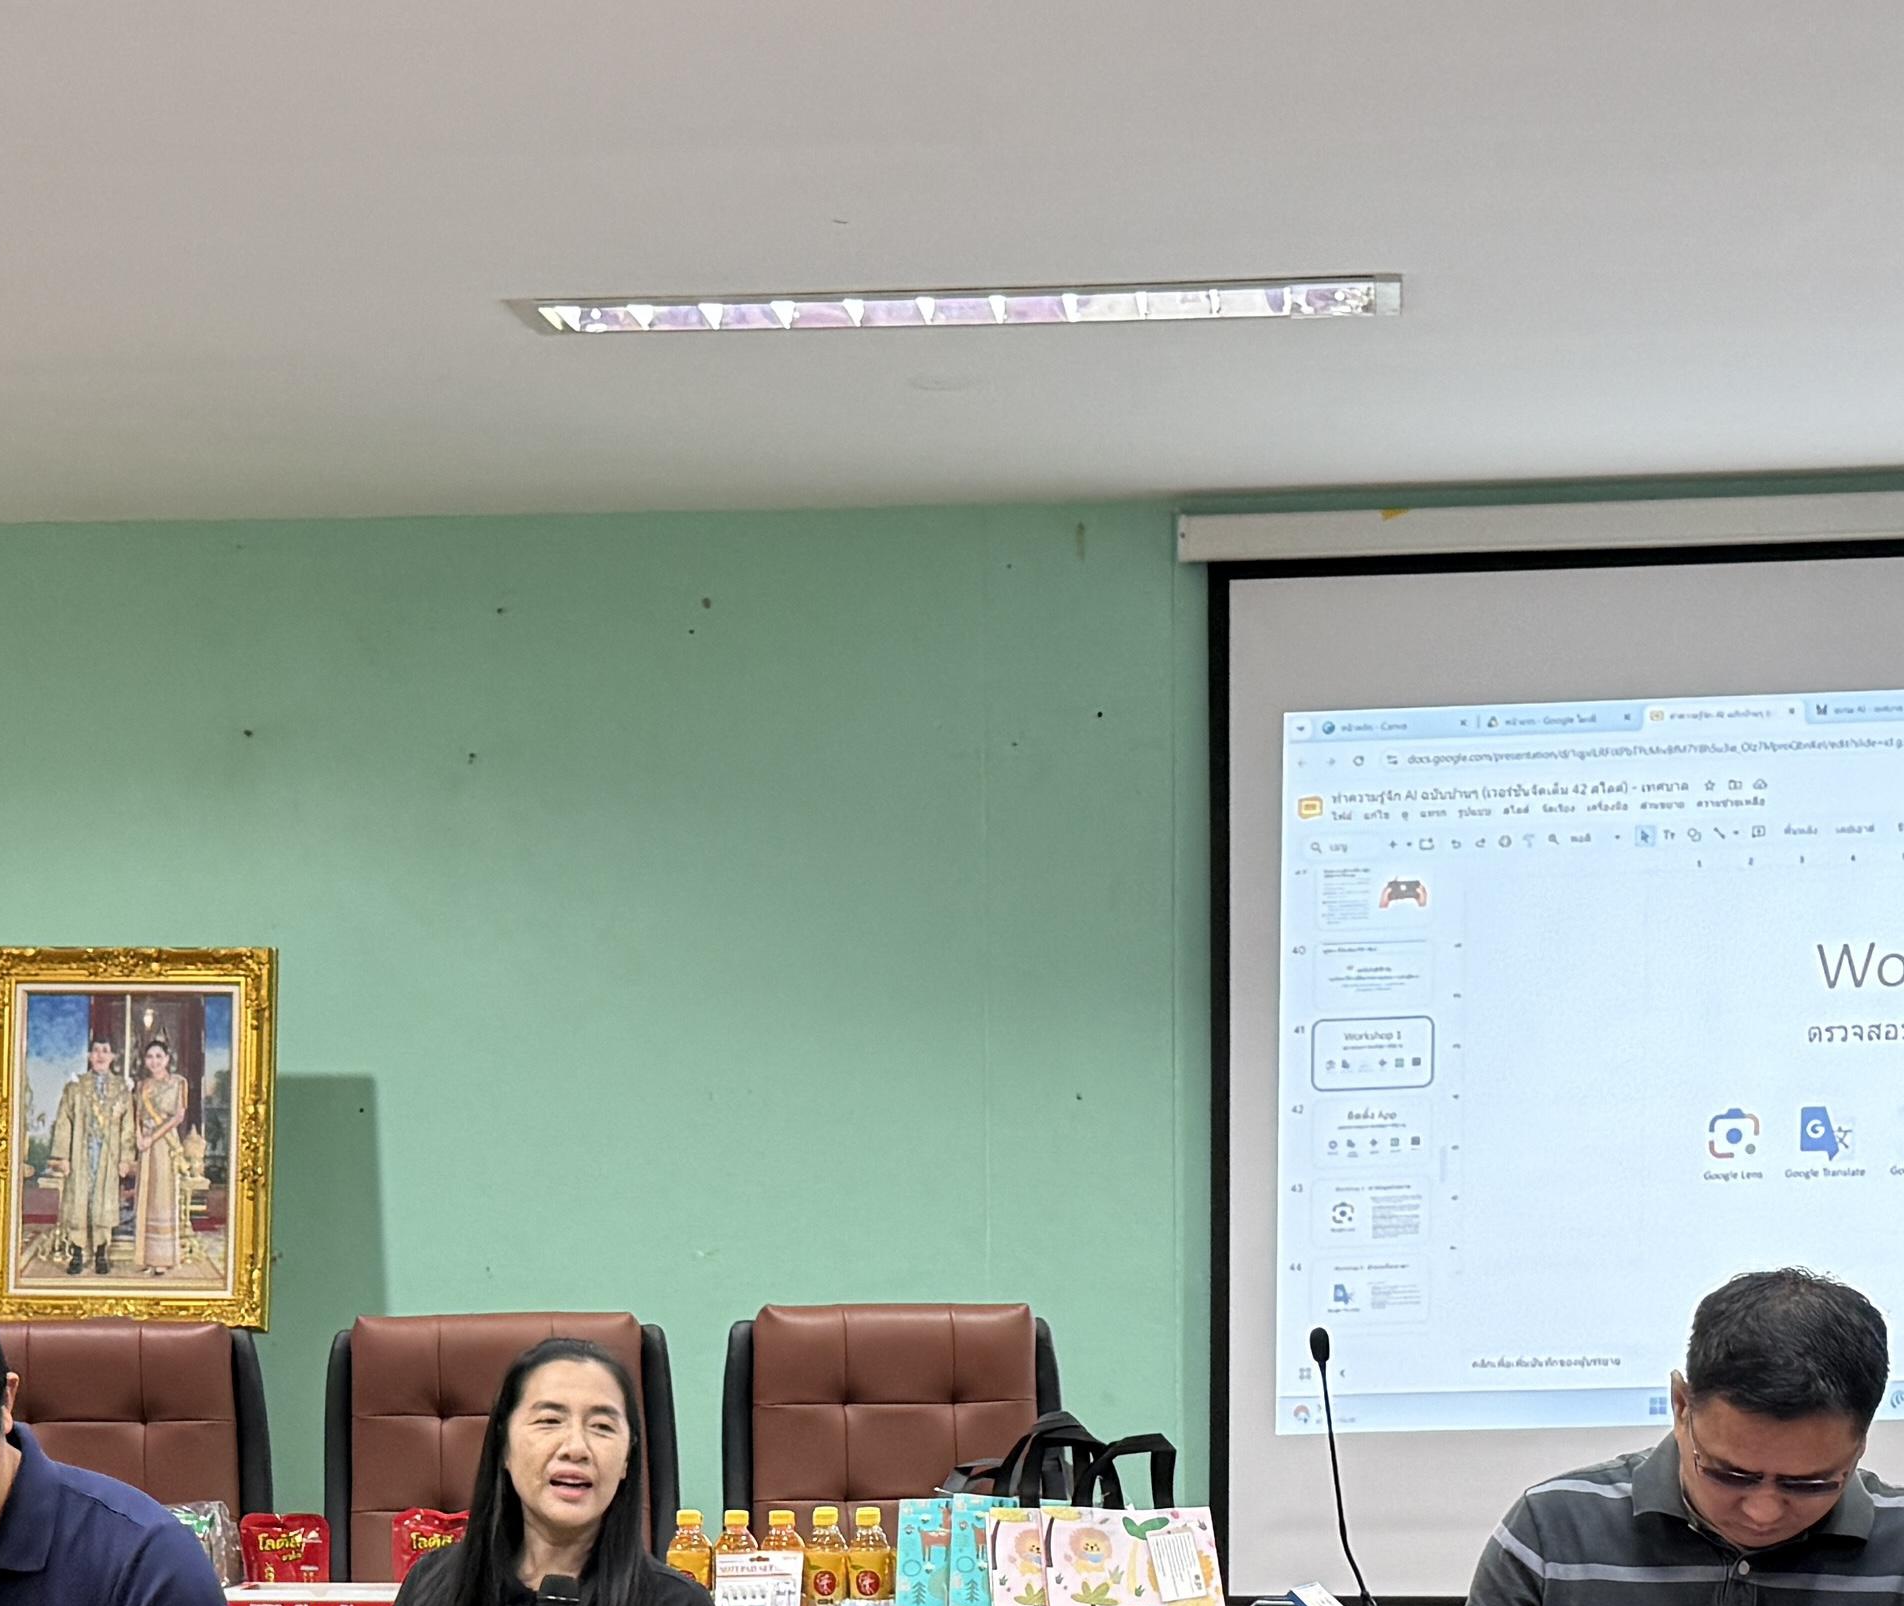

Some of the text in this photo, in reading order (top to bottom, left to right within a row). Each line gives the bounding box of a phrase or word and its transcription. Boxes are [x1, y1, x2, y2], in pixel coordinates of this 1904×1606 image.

[1404, 790, 1418, 801] AI
[1572, 784, 1587, 795] 42
[1343, 1031, 1394, 1043] Workshop
[1703, 1170, 1764, 1182] Google Lens
[1785, 1167, 1866, 1180] Google Translate
